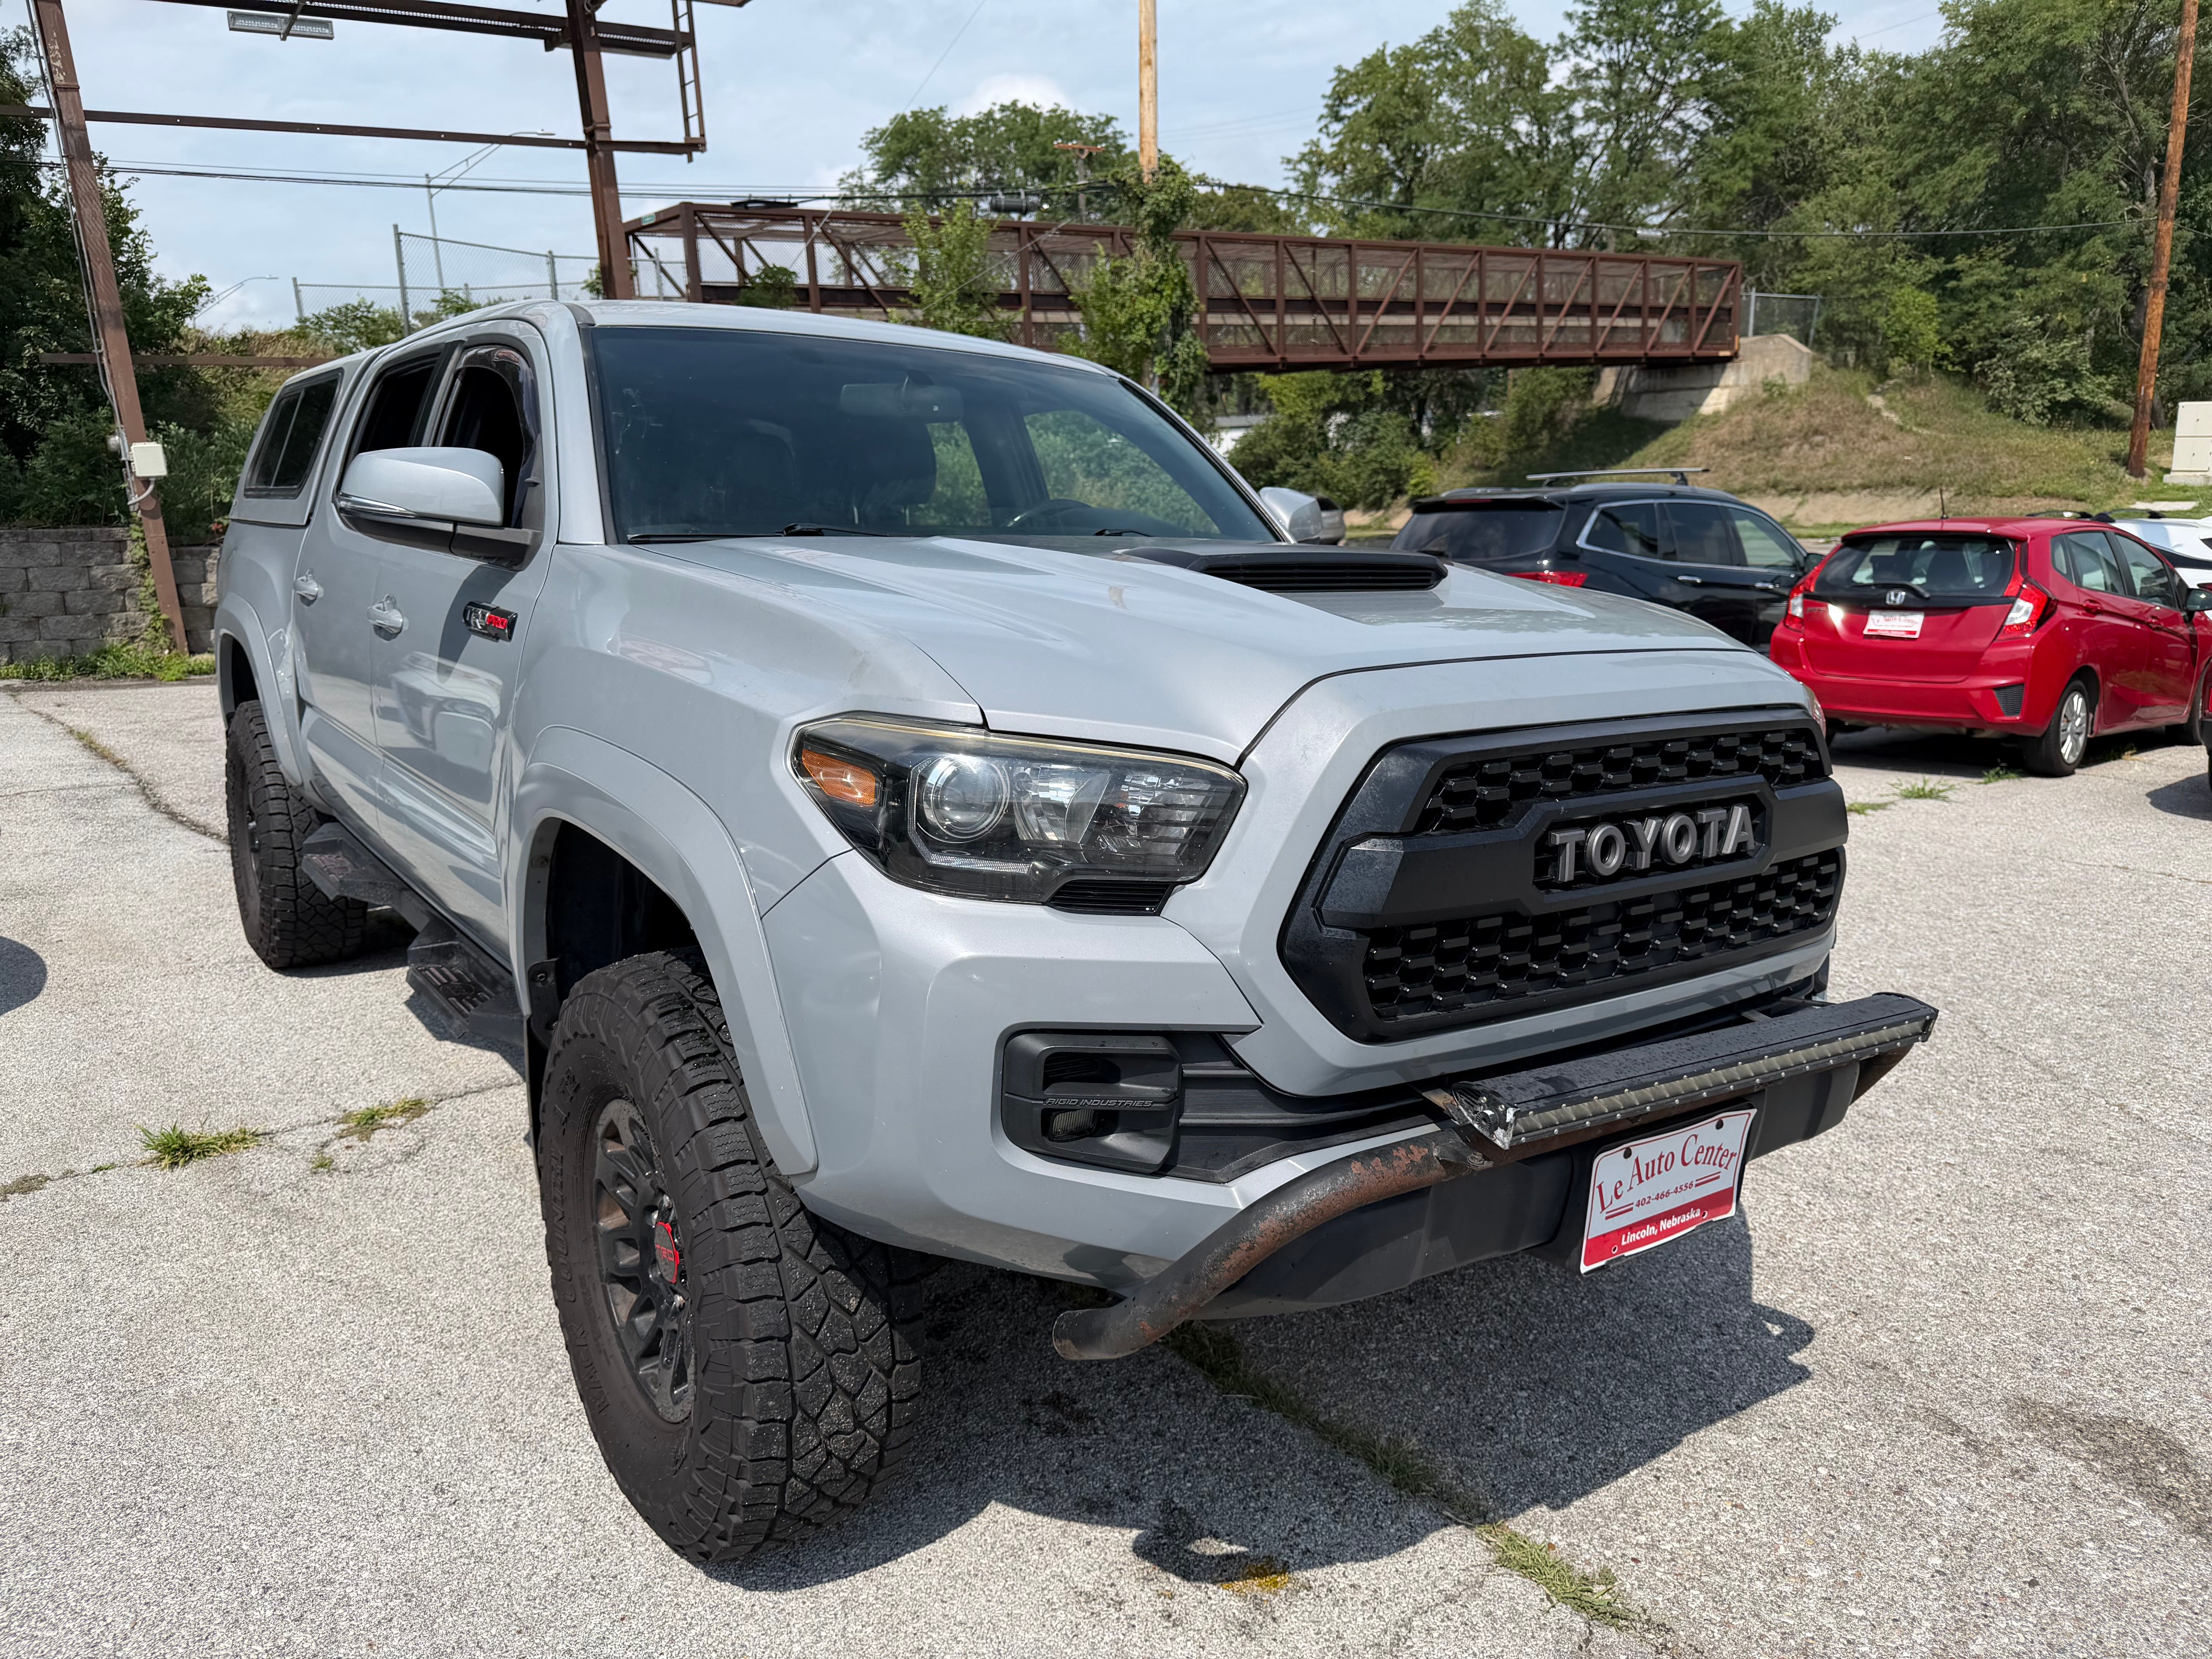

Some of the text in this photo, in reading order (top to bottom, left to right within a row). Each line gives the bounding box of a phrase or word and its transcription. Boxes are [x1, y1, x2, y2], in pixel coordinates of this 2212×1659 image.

[1550, 804, 1755, 883] TOYOTA
[1046, 1097, 1153, 1107] RIGID INDUSTRIES
[1596, 1134, 1737, 1213] Le Auto Center
[1635, 1180, 1694, 1208] 402-466-4556
[1621, 1207, 1700, 1245] Lincoln, Nebraska
[654, 1243, 674, 1262] TRD
